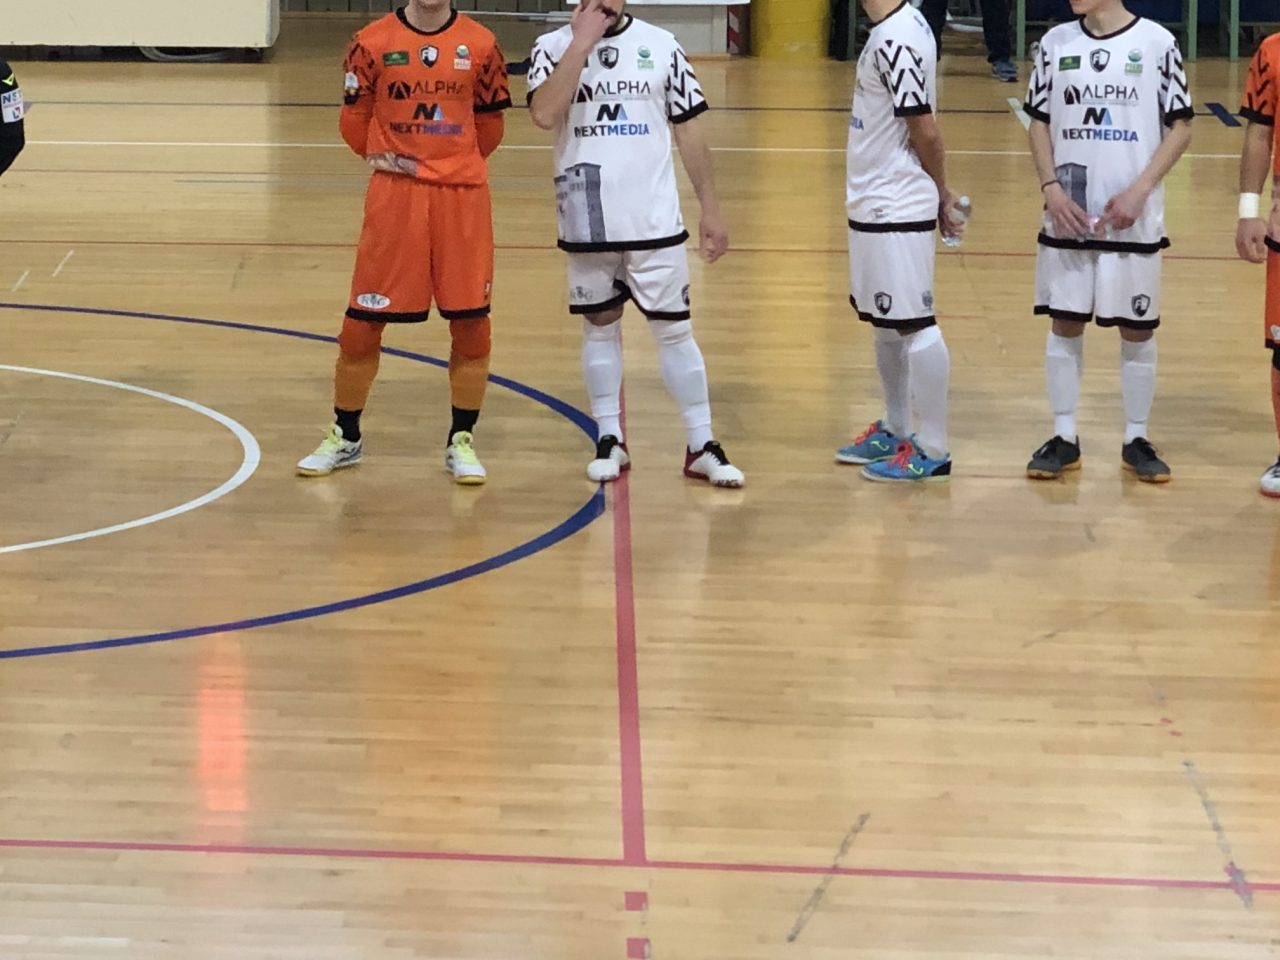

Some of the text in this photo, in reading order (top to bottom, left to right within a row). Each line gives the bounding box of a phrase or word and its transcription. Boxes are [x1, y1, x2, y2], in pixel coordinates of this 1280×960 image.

[594, 81, 651, 95] ALPHA
[1082, 85, 1139, 100] ALPHA
[574, 124, 650, 138] NEXTMEDIA
